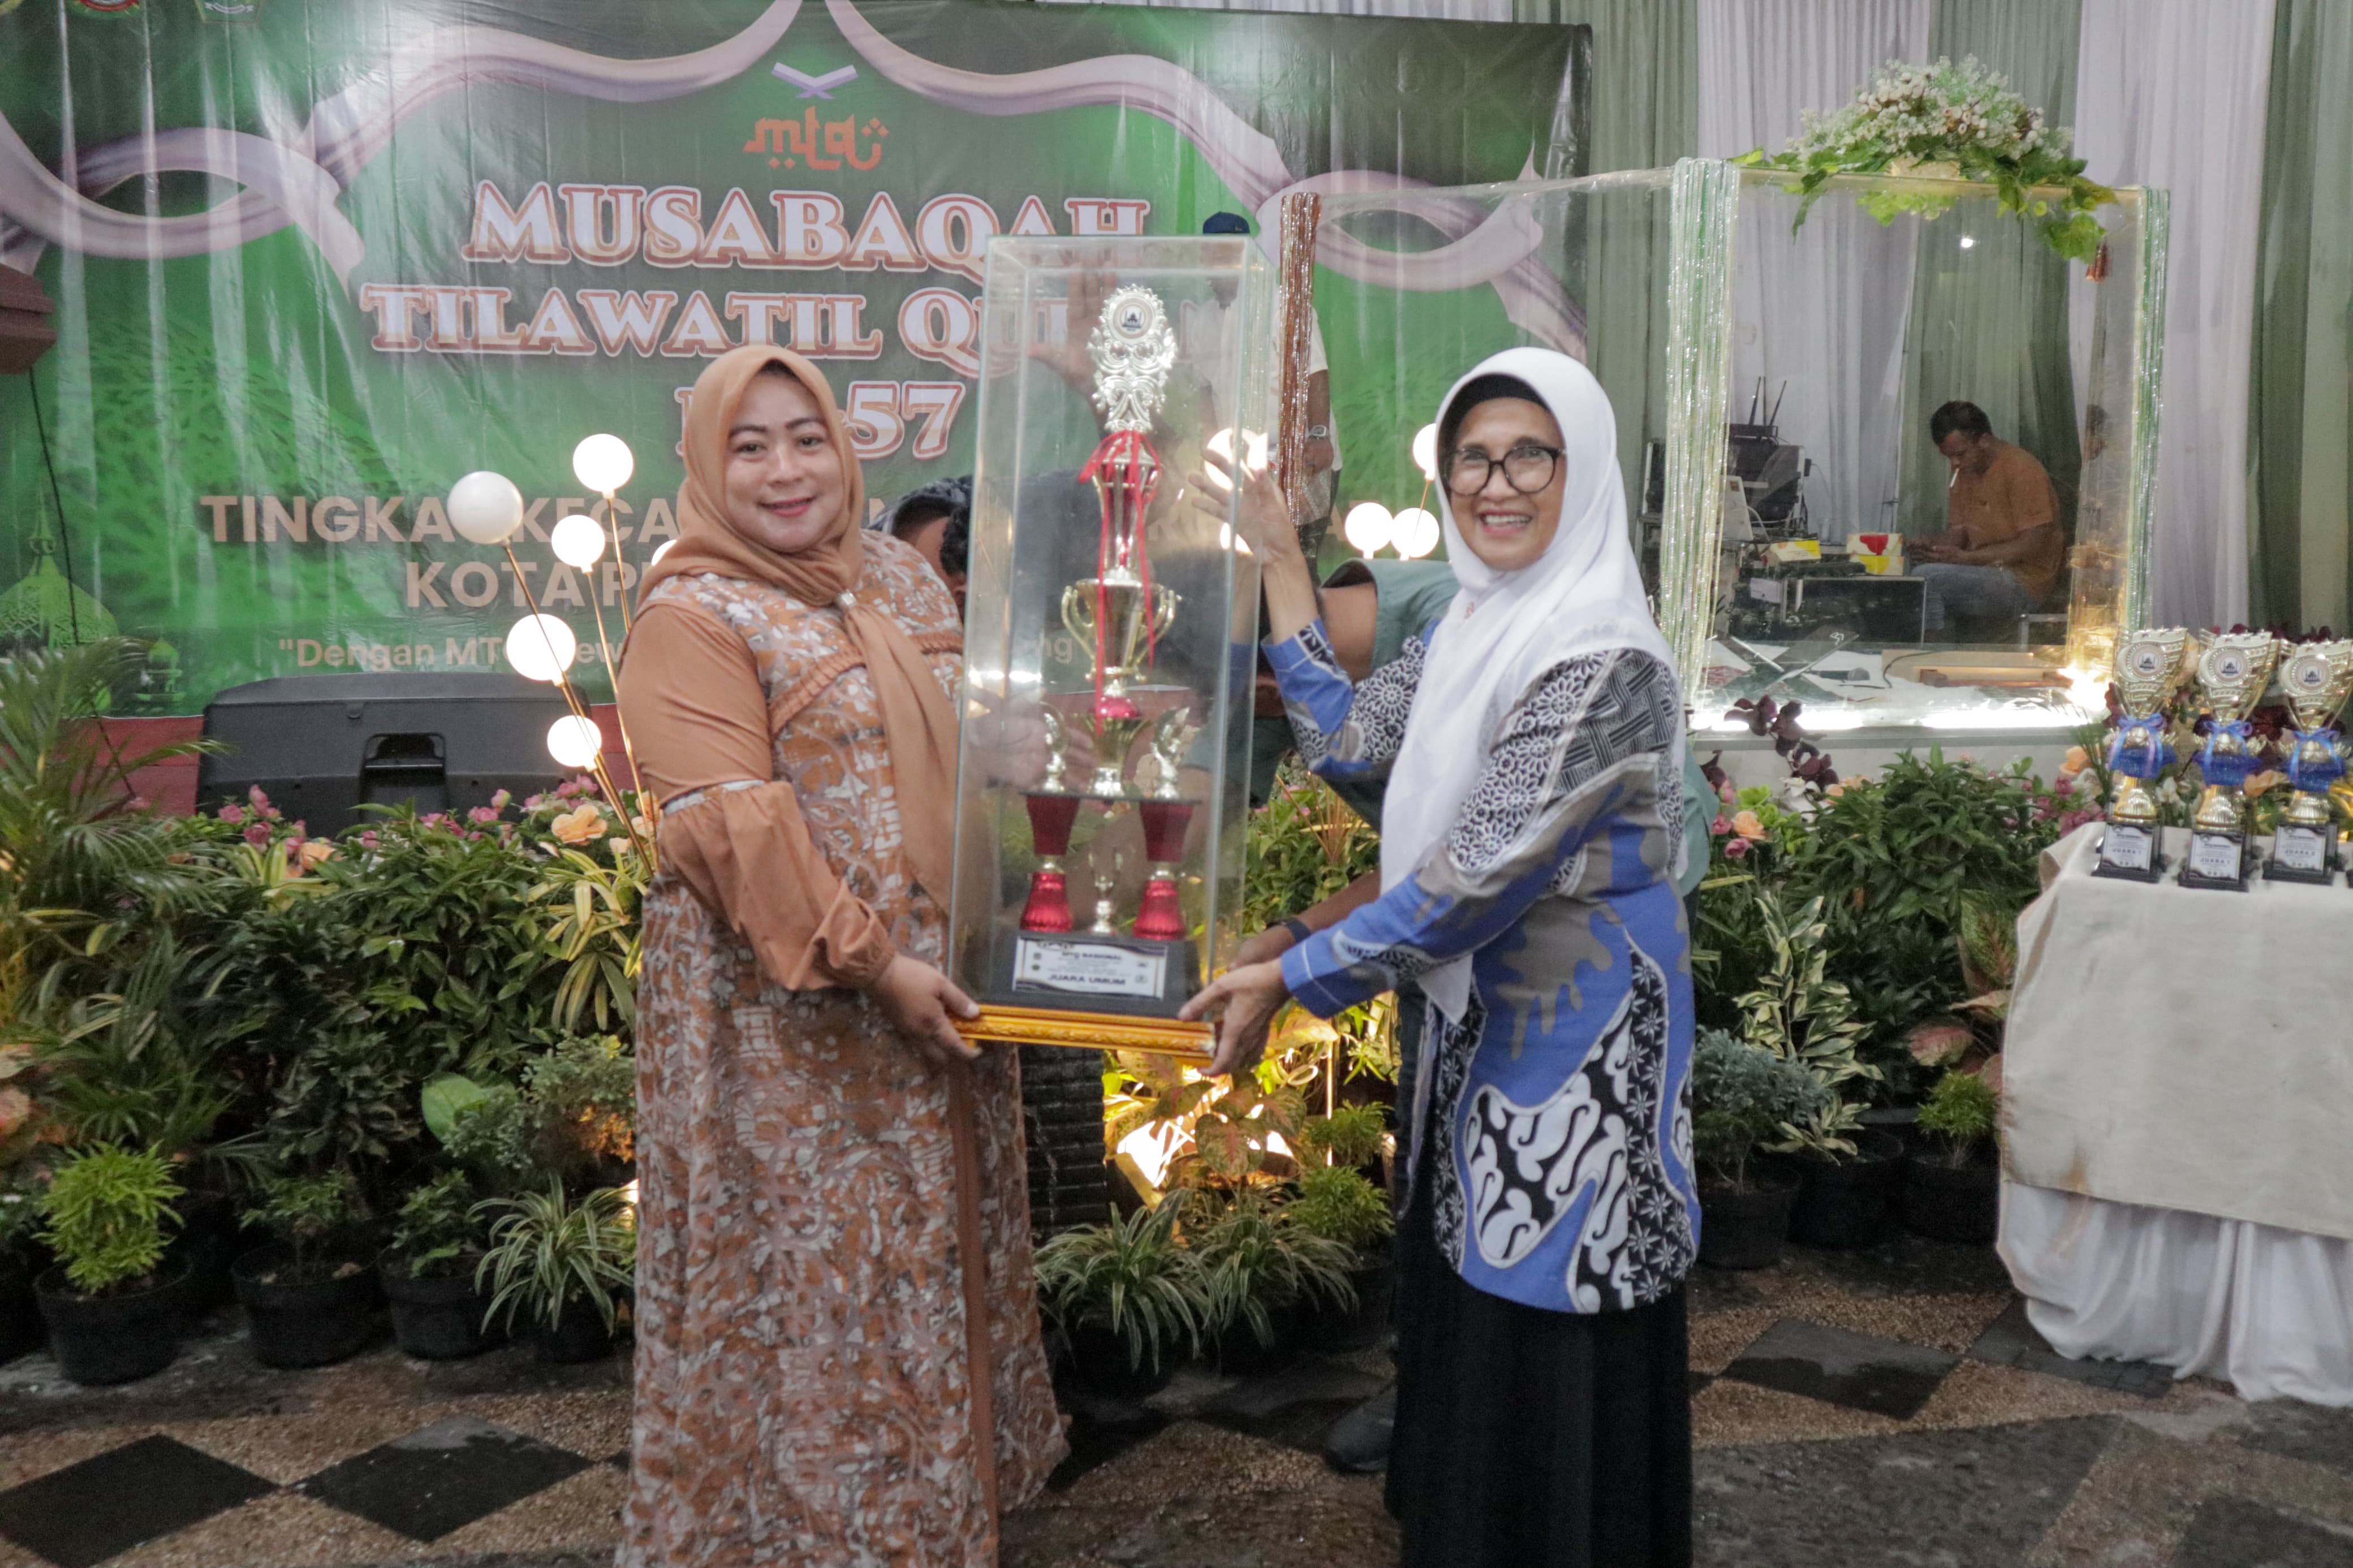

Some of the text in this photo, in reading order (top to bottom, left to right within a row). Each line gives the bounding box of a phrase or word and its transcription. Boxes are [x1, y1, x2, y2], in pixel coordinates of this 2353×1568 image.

[360, 284, 884, 361] TILAWATIL
[200, 495, 456, 543] TINGKA
[406, 561, 585, 608] KOTA
[446, 638, 509, 666] MT
